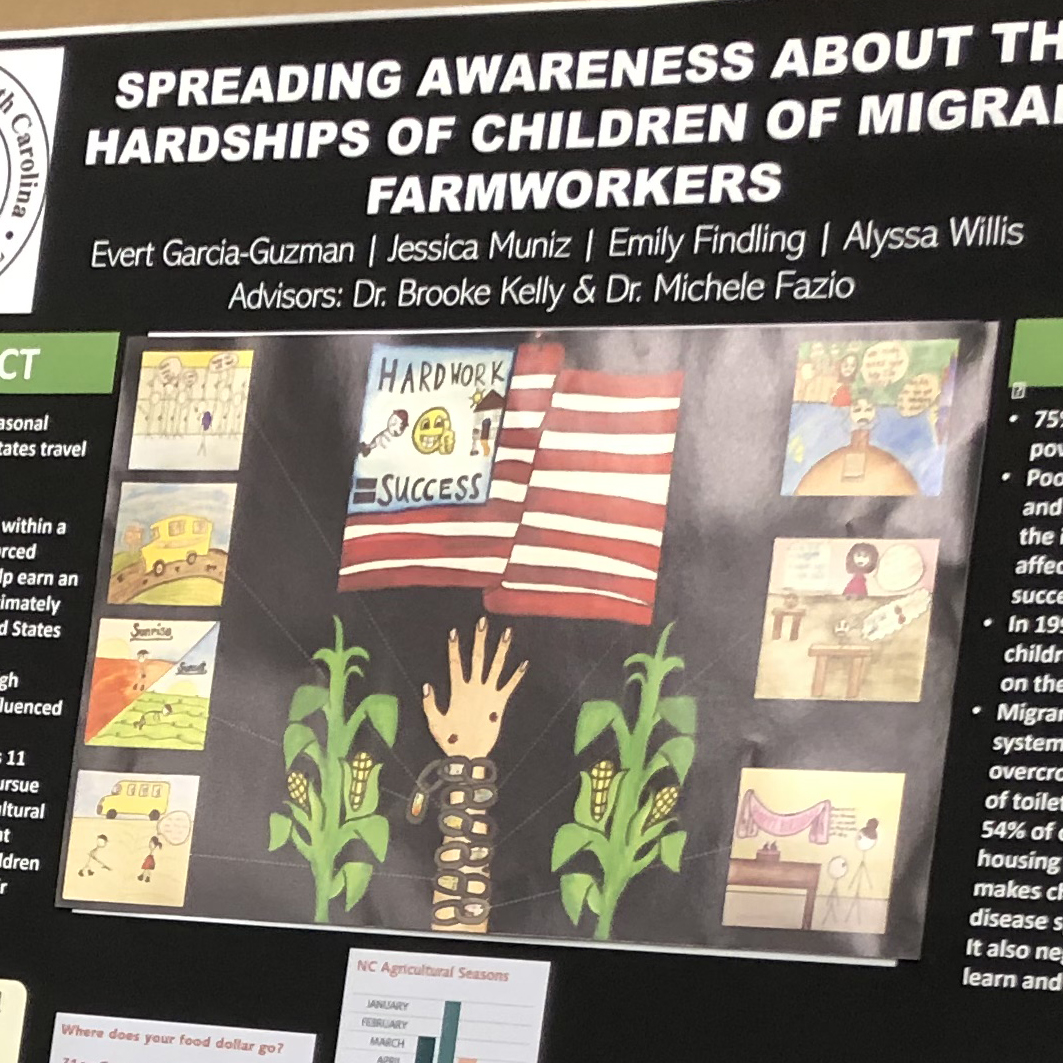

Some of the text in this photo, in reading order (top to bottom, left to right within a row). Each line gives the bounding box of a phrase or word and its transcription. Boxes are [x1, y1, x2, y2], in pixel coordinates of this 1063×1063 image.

[115, 59, 401, 109] SPREADING
[416, 41, 754, 96] AWARENESS
[769, 25, 974, 79] ABOUT
[85, 83, 1063, 165] HARDSHIPS OF CHILDREN OF MIGRA
[11, 113, 39, 218] Carolina
[366, 162, 782, 214] FARMWORKERS
[91, 215, 1024, 267] Evert Garcia-Guzman Jessica Muniz Emily Findling Alyssa Willis
[227, 269, 855, 312] Advisors: Dr. Brooke Kelly & Dr. Michele Fazio
[377, 473, 482, 506] SUCCESS
[1, 516, 52, 534] within
[56, 521, 66, 535] a
[981, 820, 1026, 839] 54%
[977, 848, 1062, 875] housing
[973, 879, 1042, 900] makes
[969, 907, 1049, 930] disease
[966, 938, 1031, 959] It also
[356, 959, 509, 982] NC Agricultural Seasons
[962, 966, 1063, 991] learn and
[61, 1023, 284, 1056] Where does your food dollar go?
